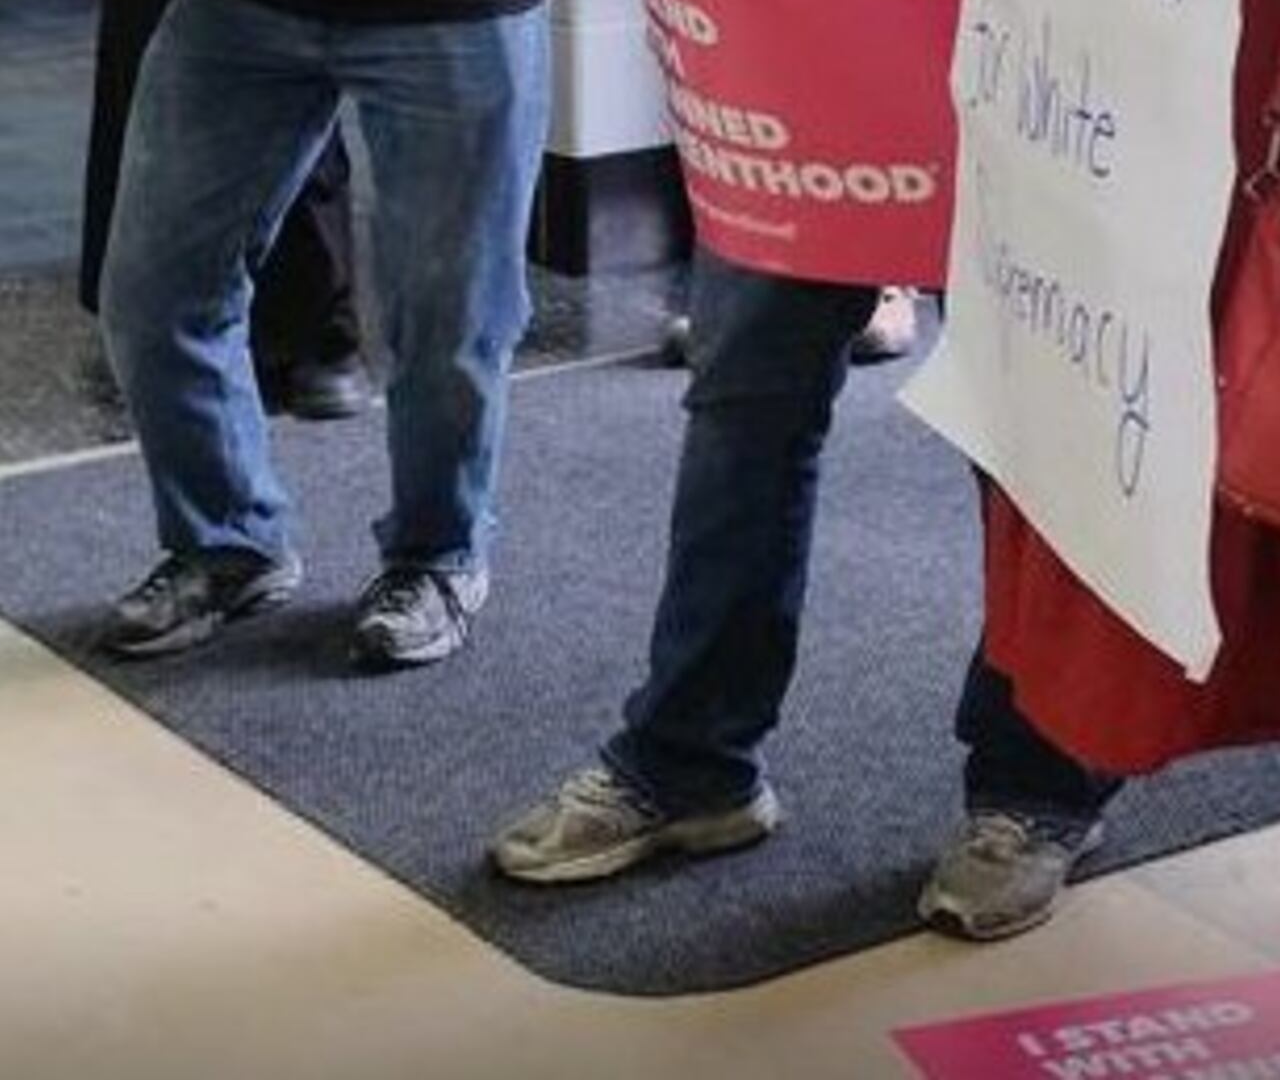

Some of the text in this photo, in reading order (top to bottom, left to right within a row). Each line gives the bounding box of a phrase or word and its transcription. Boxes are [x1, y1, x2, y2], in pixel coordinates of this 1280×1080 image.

[670, 82, 791, 151] NNED
[678, 128, 936, 204] ENTHOOD
[1053, 998, 1256, 1052] STAND
